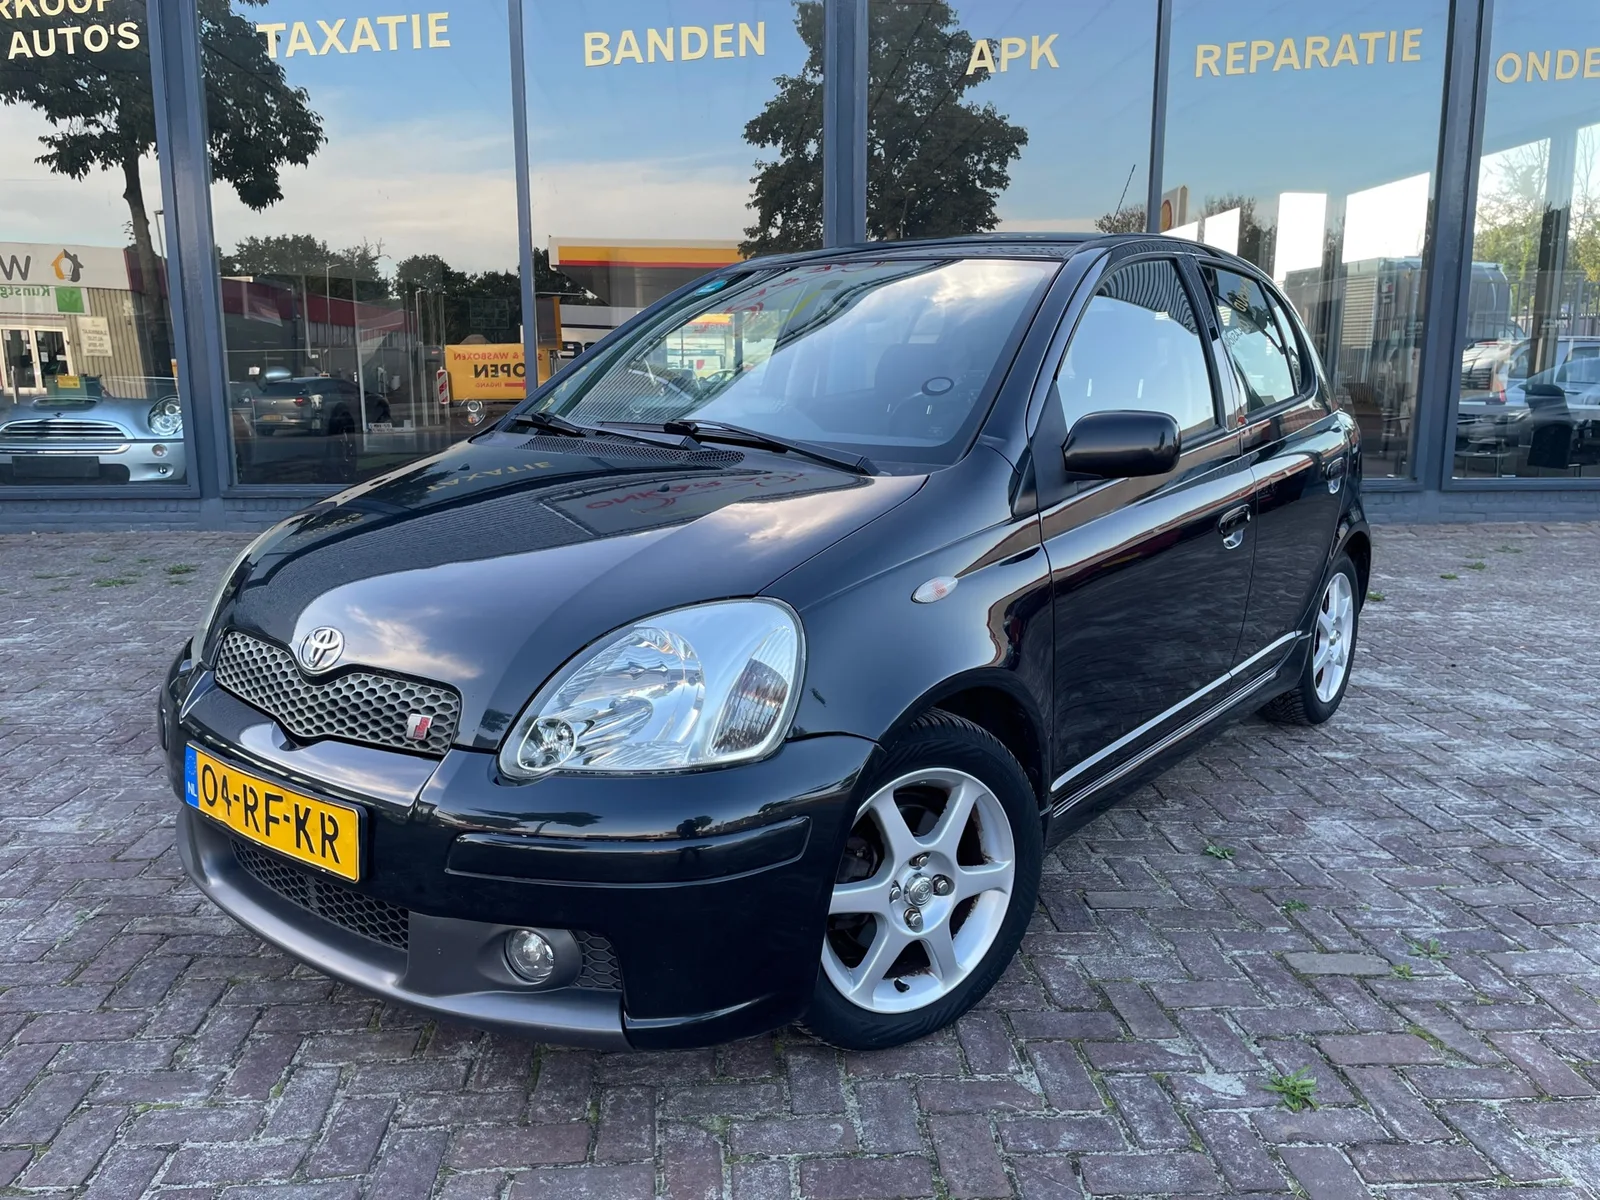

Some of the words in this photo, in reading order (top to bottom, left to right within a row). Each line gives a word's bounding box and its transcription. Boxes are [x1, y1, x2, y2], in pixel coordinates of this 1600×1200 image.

[8, 22, 140, 60] AUTO'S
[256, 12, 450, 59] TAXATIE
[584, 21, 766, 67] BANDEN
[965, 33, 1060, 76] APK
[1195, 28, 1423, 77] REPARATIE
[1495, 47, 1600, 84] ONDE
[187, 780, 198, 798] NL
[202, 764, 341, 865] 04-RF-KR
